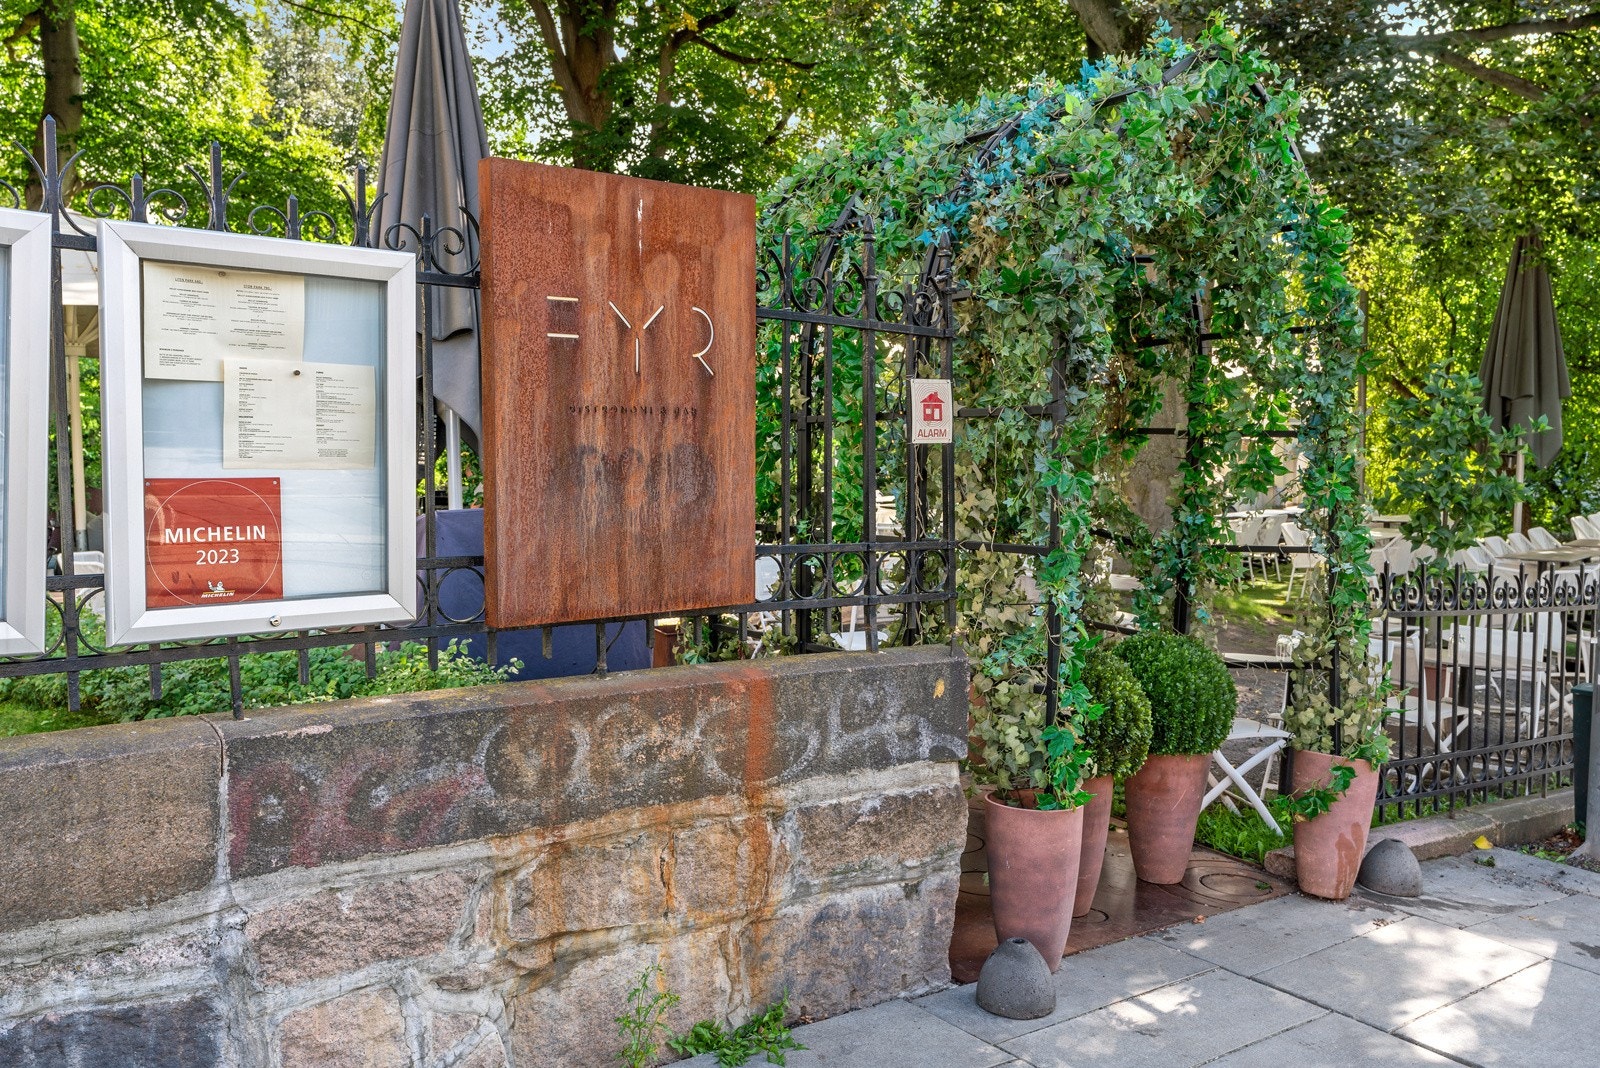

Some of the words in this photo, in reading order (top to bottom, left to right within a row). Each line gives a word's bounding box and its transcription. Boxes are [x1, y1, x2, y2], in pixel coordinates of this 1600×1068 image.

[917, 428, 947, 438] ALARM
[164, 525, 266, 543] MICHELIN
[195, 548, 240, 566] 2023
